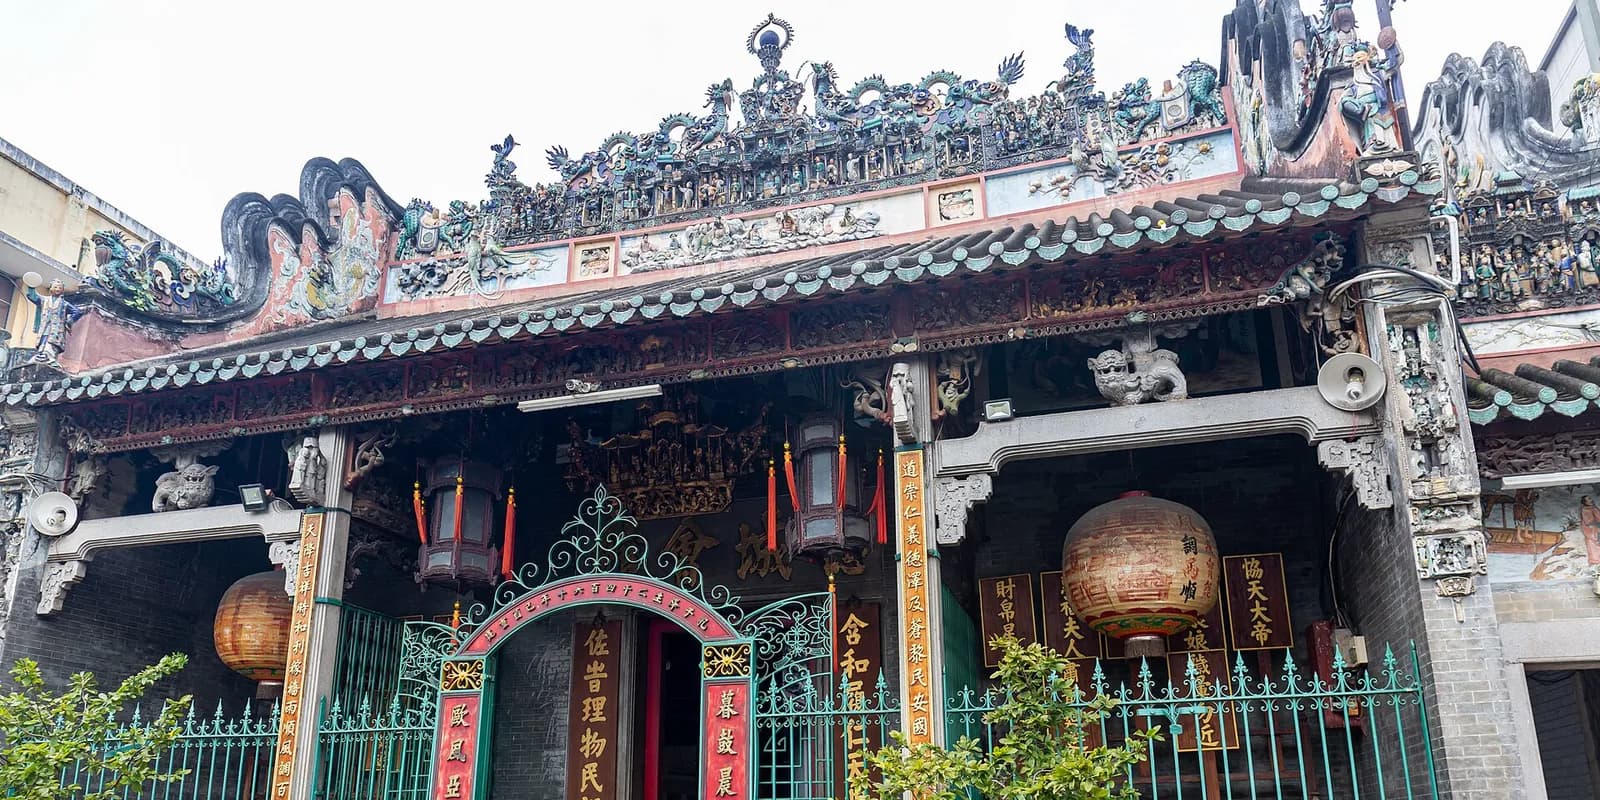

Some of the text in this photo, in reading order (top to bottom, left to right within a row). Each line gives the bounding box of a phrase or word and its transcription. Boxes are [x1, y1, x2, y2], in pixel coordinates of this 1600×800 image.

[902, 459, 929, 752] 道崇仁義德澤及蒼黎民安國
[995, 578, 1017, 643] 財帛星
[1060, 576, 1085, 658] 福夫人
[1242, 557, 1273, 647] 協天大帝
[444, 703, 470, 799] 歐風亞
